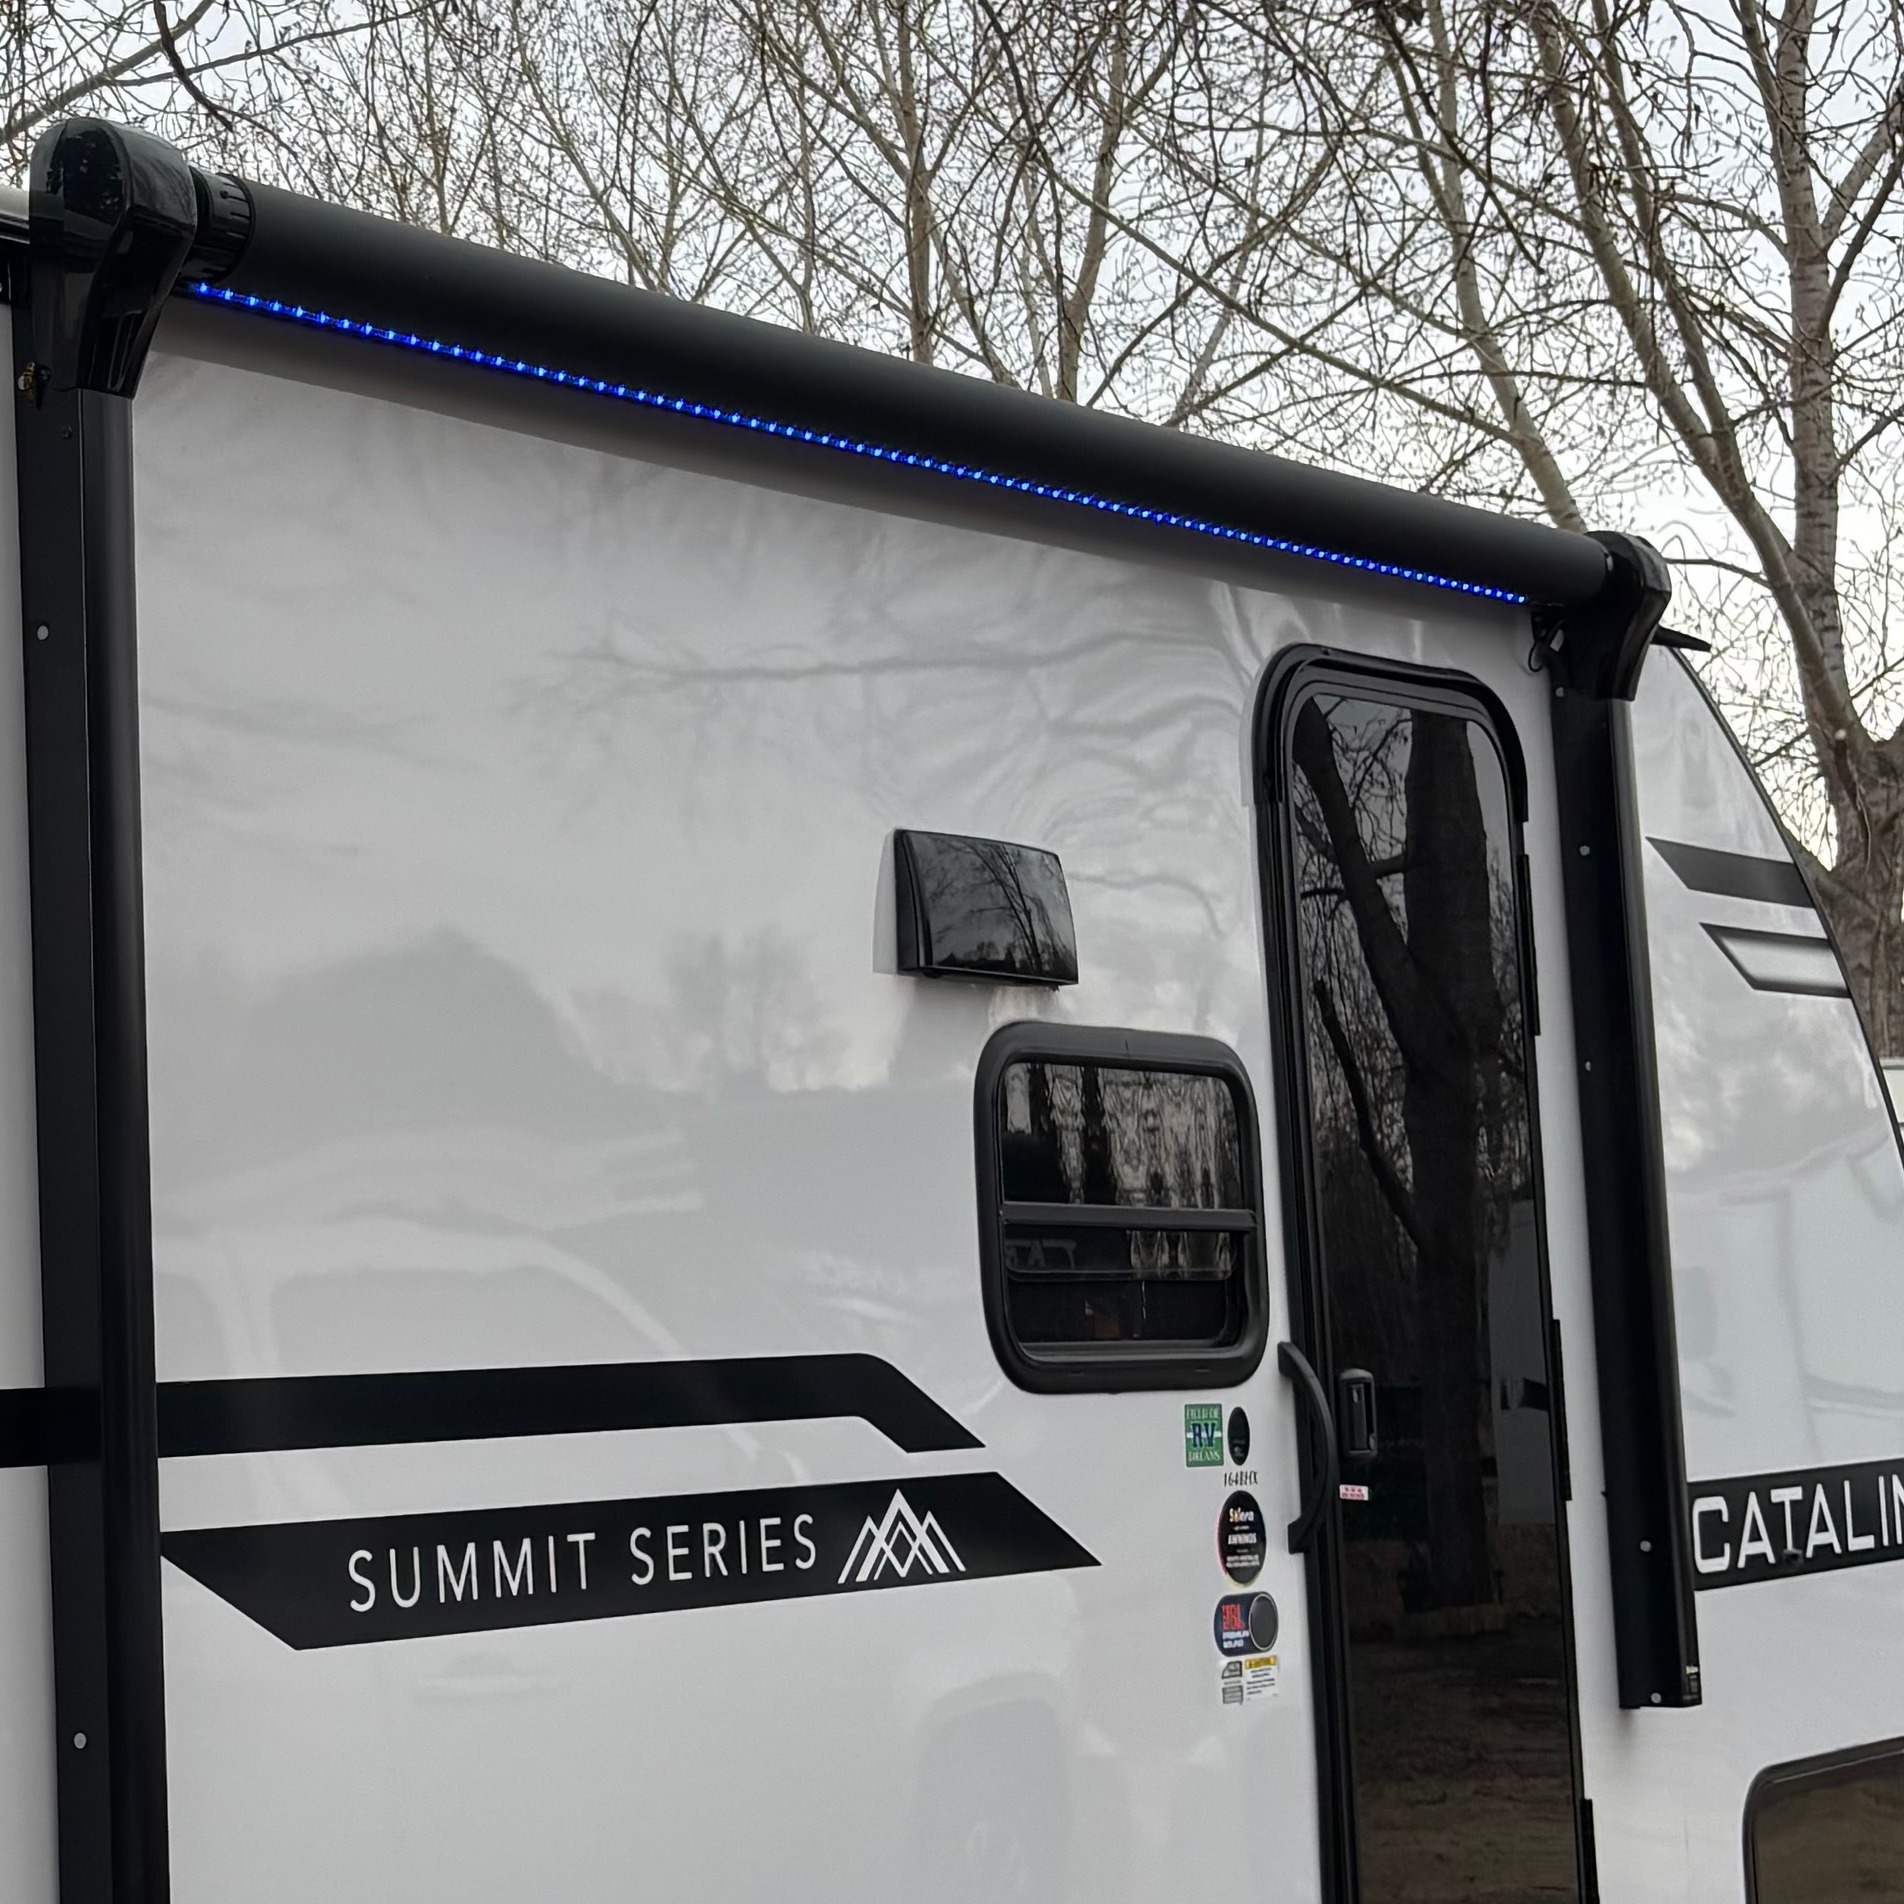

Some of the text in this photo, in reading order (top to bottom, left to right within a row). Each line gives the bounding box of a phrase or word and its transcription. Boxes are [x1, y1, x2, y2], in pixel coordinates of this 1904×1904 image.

[1191, 1421, 1217, 1448] RV
[348, 1512, 817, 1614] SUMMIT SERIES
